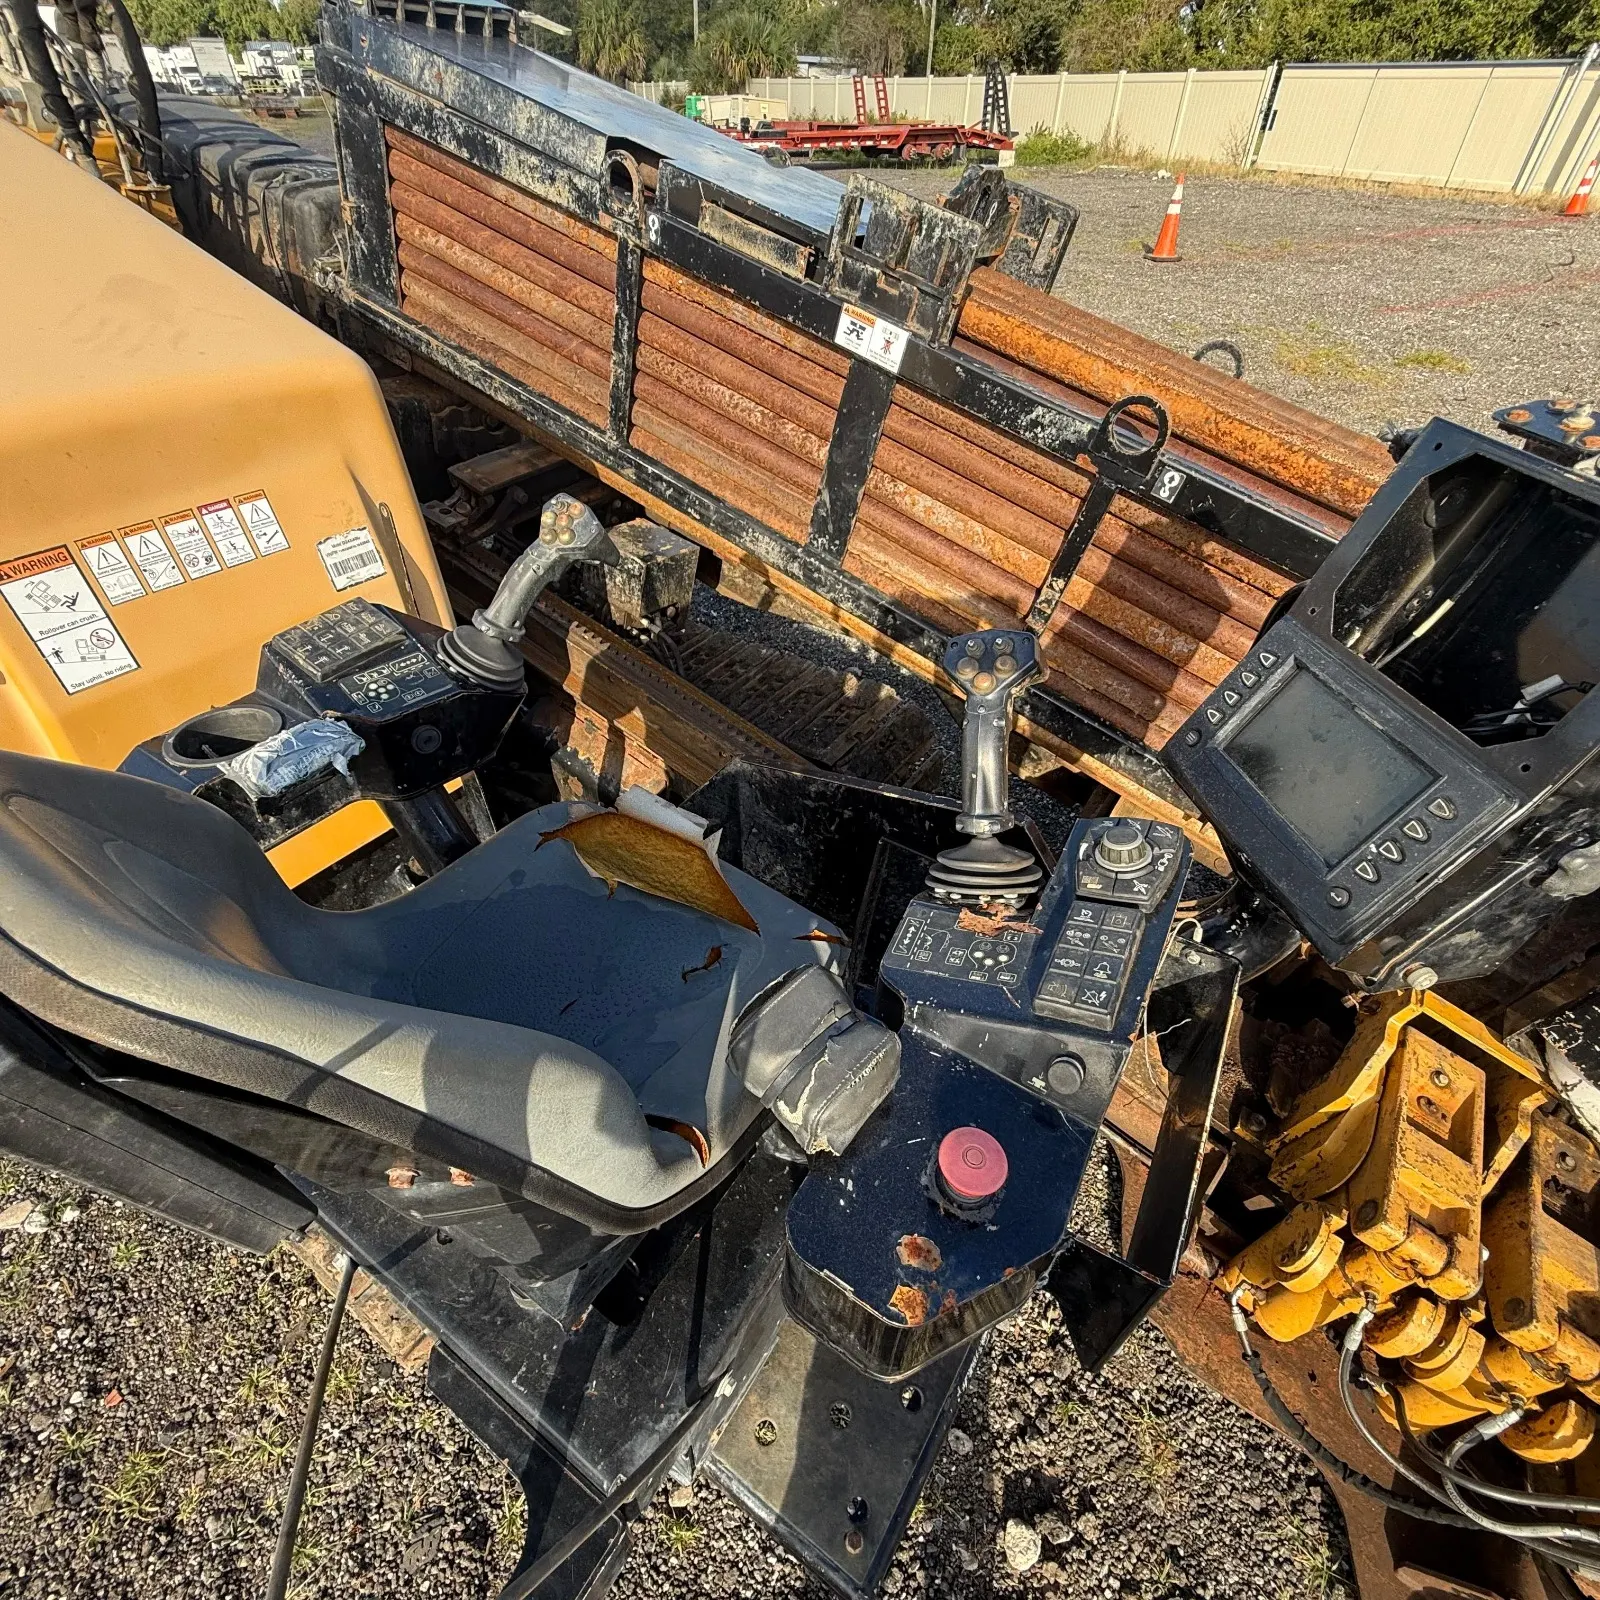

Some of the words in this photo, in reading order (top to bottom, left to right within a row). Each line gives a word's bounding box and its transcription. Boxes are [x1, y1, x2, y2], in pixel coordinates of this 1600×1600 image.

[850, 307, 876, 325] WARNING
[243, 492, 263, 501] WARNING
[208, 502, 228, 511] DANGER
[169, 512, 192, 522] WARNING
[129, 523, 153, 534] WARNING
[86, 534, 112, 545] WARNING
[8, 551, 69, 576] WARNING
[38, 622, 66, 637] Rollover
[66, 618, 78, 628] can
[79, 612, 98, 623] crush.
[70, 680, 85, 690] Stay
[85, 672, 104, 684] uphill.
[104, 668, 114, 677] No
[114, 661, 133, 674] riding.
